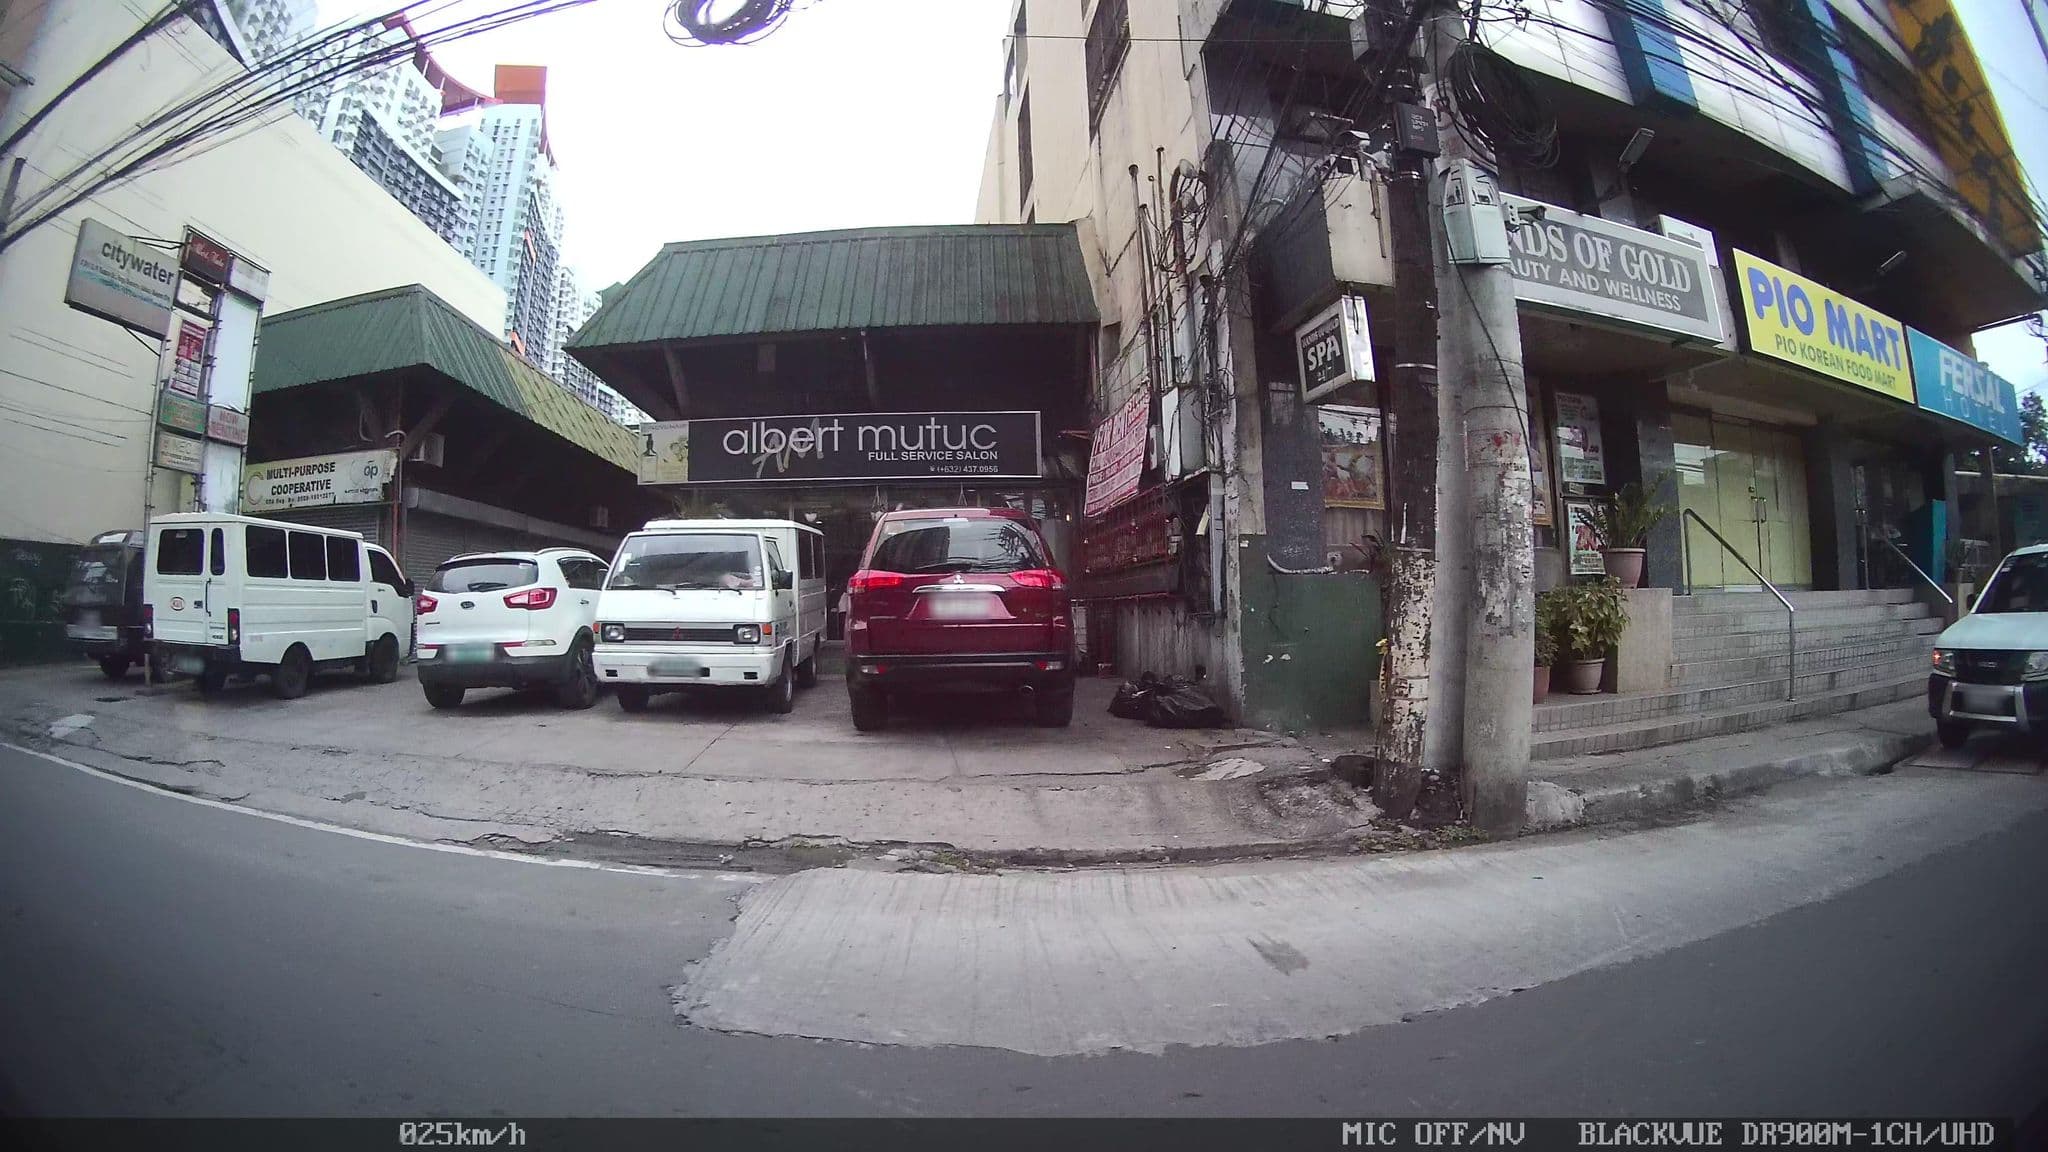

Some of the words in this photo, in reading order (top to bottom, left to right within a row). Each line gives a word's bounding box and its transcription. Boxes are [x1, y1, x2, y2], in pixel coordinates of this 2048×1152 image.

[101, 241, 175, 285] citywater
[1574, 231, 1613, 273] OF
[1619, 244, 1691, 293] GOLD
[1559, 268, 1600, 292] AND
[1604, 278, 1681, 312] WELLNESS
[1747, 267, 1814, 336] PIO
[1824, 298, 1902, 371] MART
[1307, 335, 1341, 371] SPA
[1775, 333, 1797, 355] PIO
[1800, 342, 1845, 372] KOREAN
[1845, 359, 1873, 382] FOOD
[722, 418, 845, 456] albert
[858, 416, 997, 451] mutuc
[868, 451, 899, 462] FULL
[901, 450, 953, 461] SERVICE
[956, 450, 998, 460] SALON
[266, 461, 336, 480] MULTI-PURPOSE
[271, 479, 332, 496] COOPERATIVE
